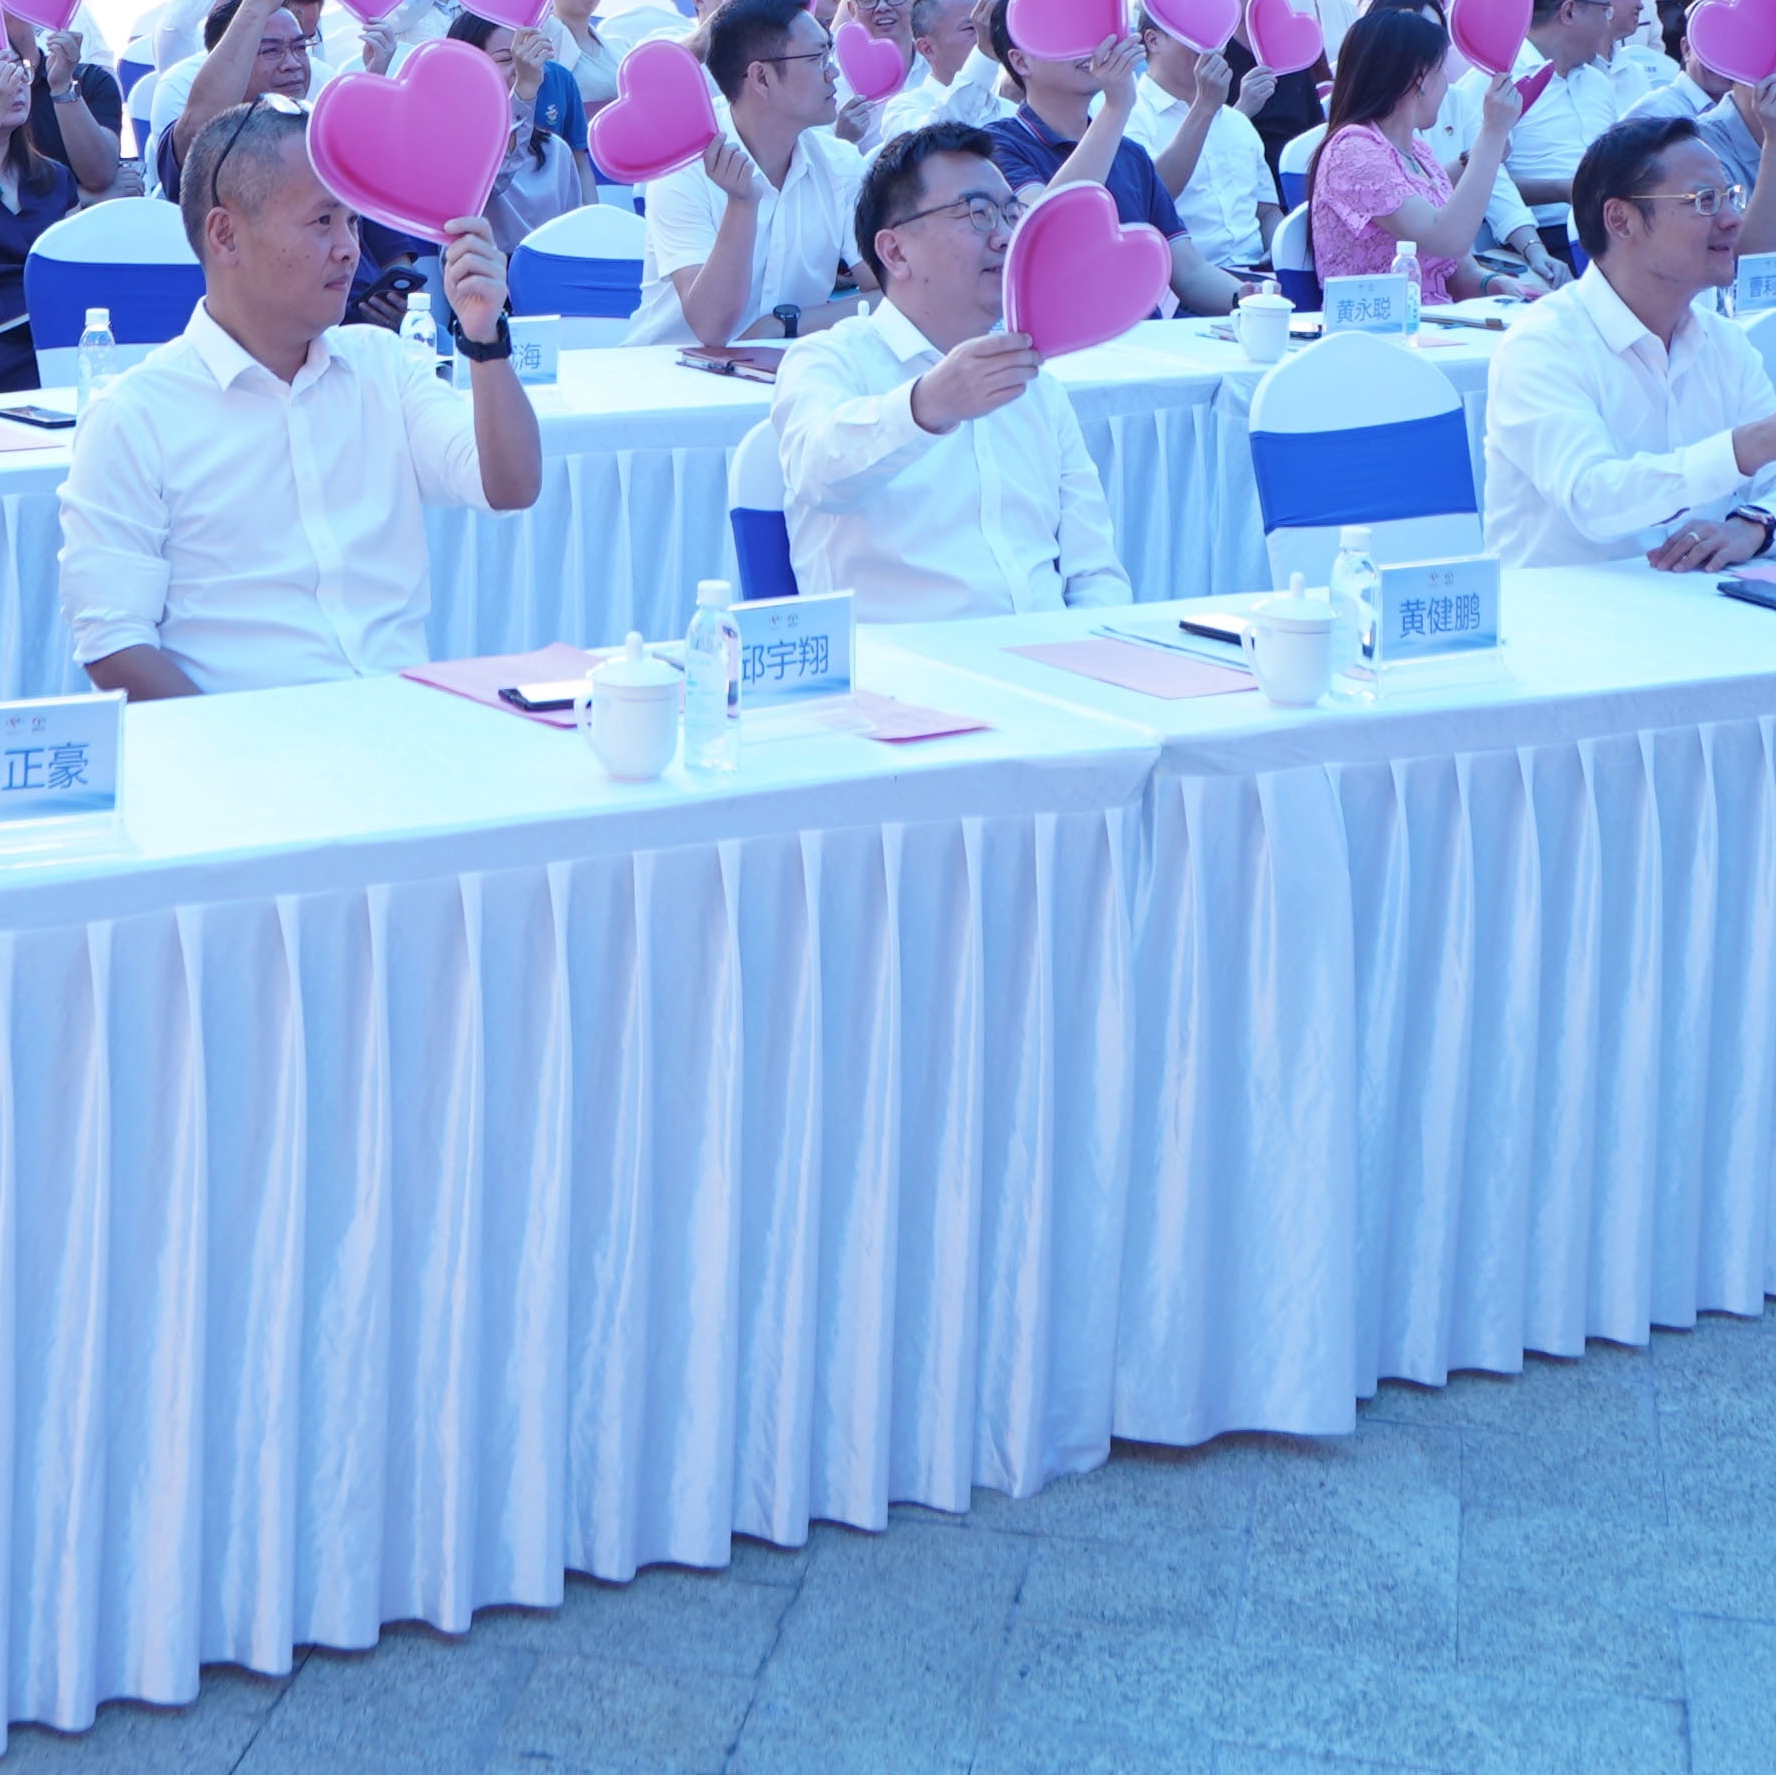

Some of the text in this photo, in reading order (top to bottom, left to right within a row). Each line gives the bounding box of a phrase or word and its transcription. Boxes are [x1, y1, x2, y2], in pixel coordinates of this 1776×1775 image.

[1335, 296, 1392, 324] 黄永聪
[1398, 592, 1481, 639] 黄健鹏
